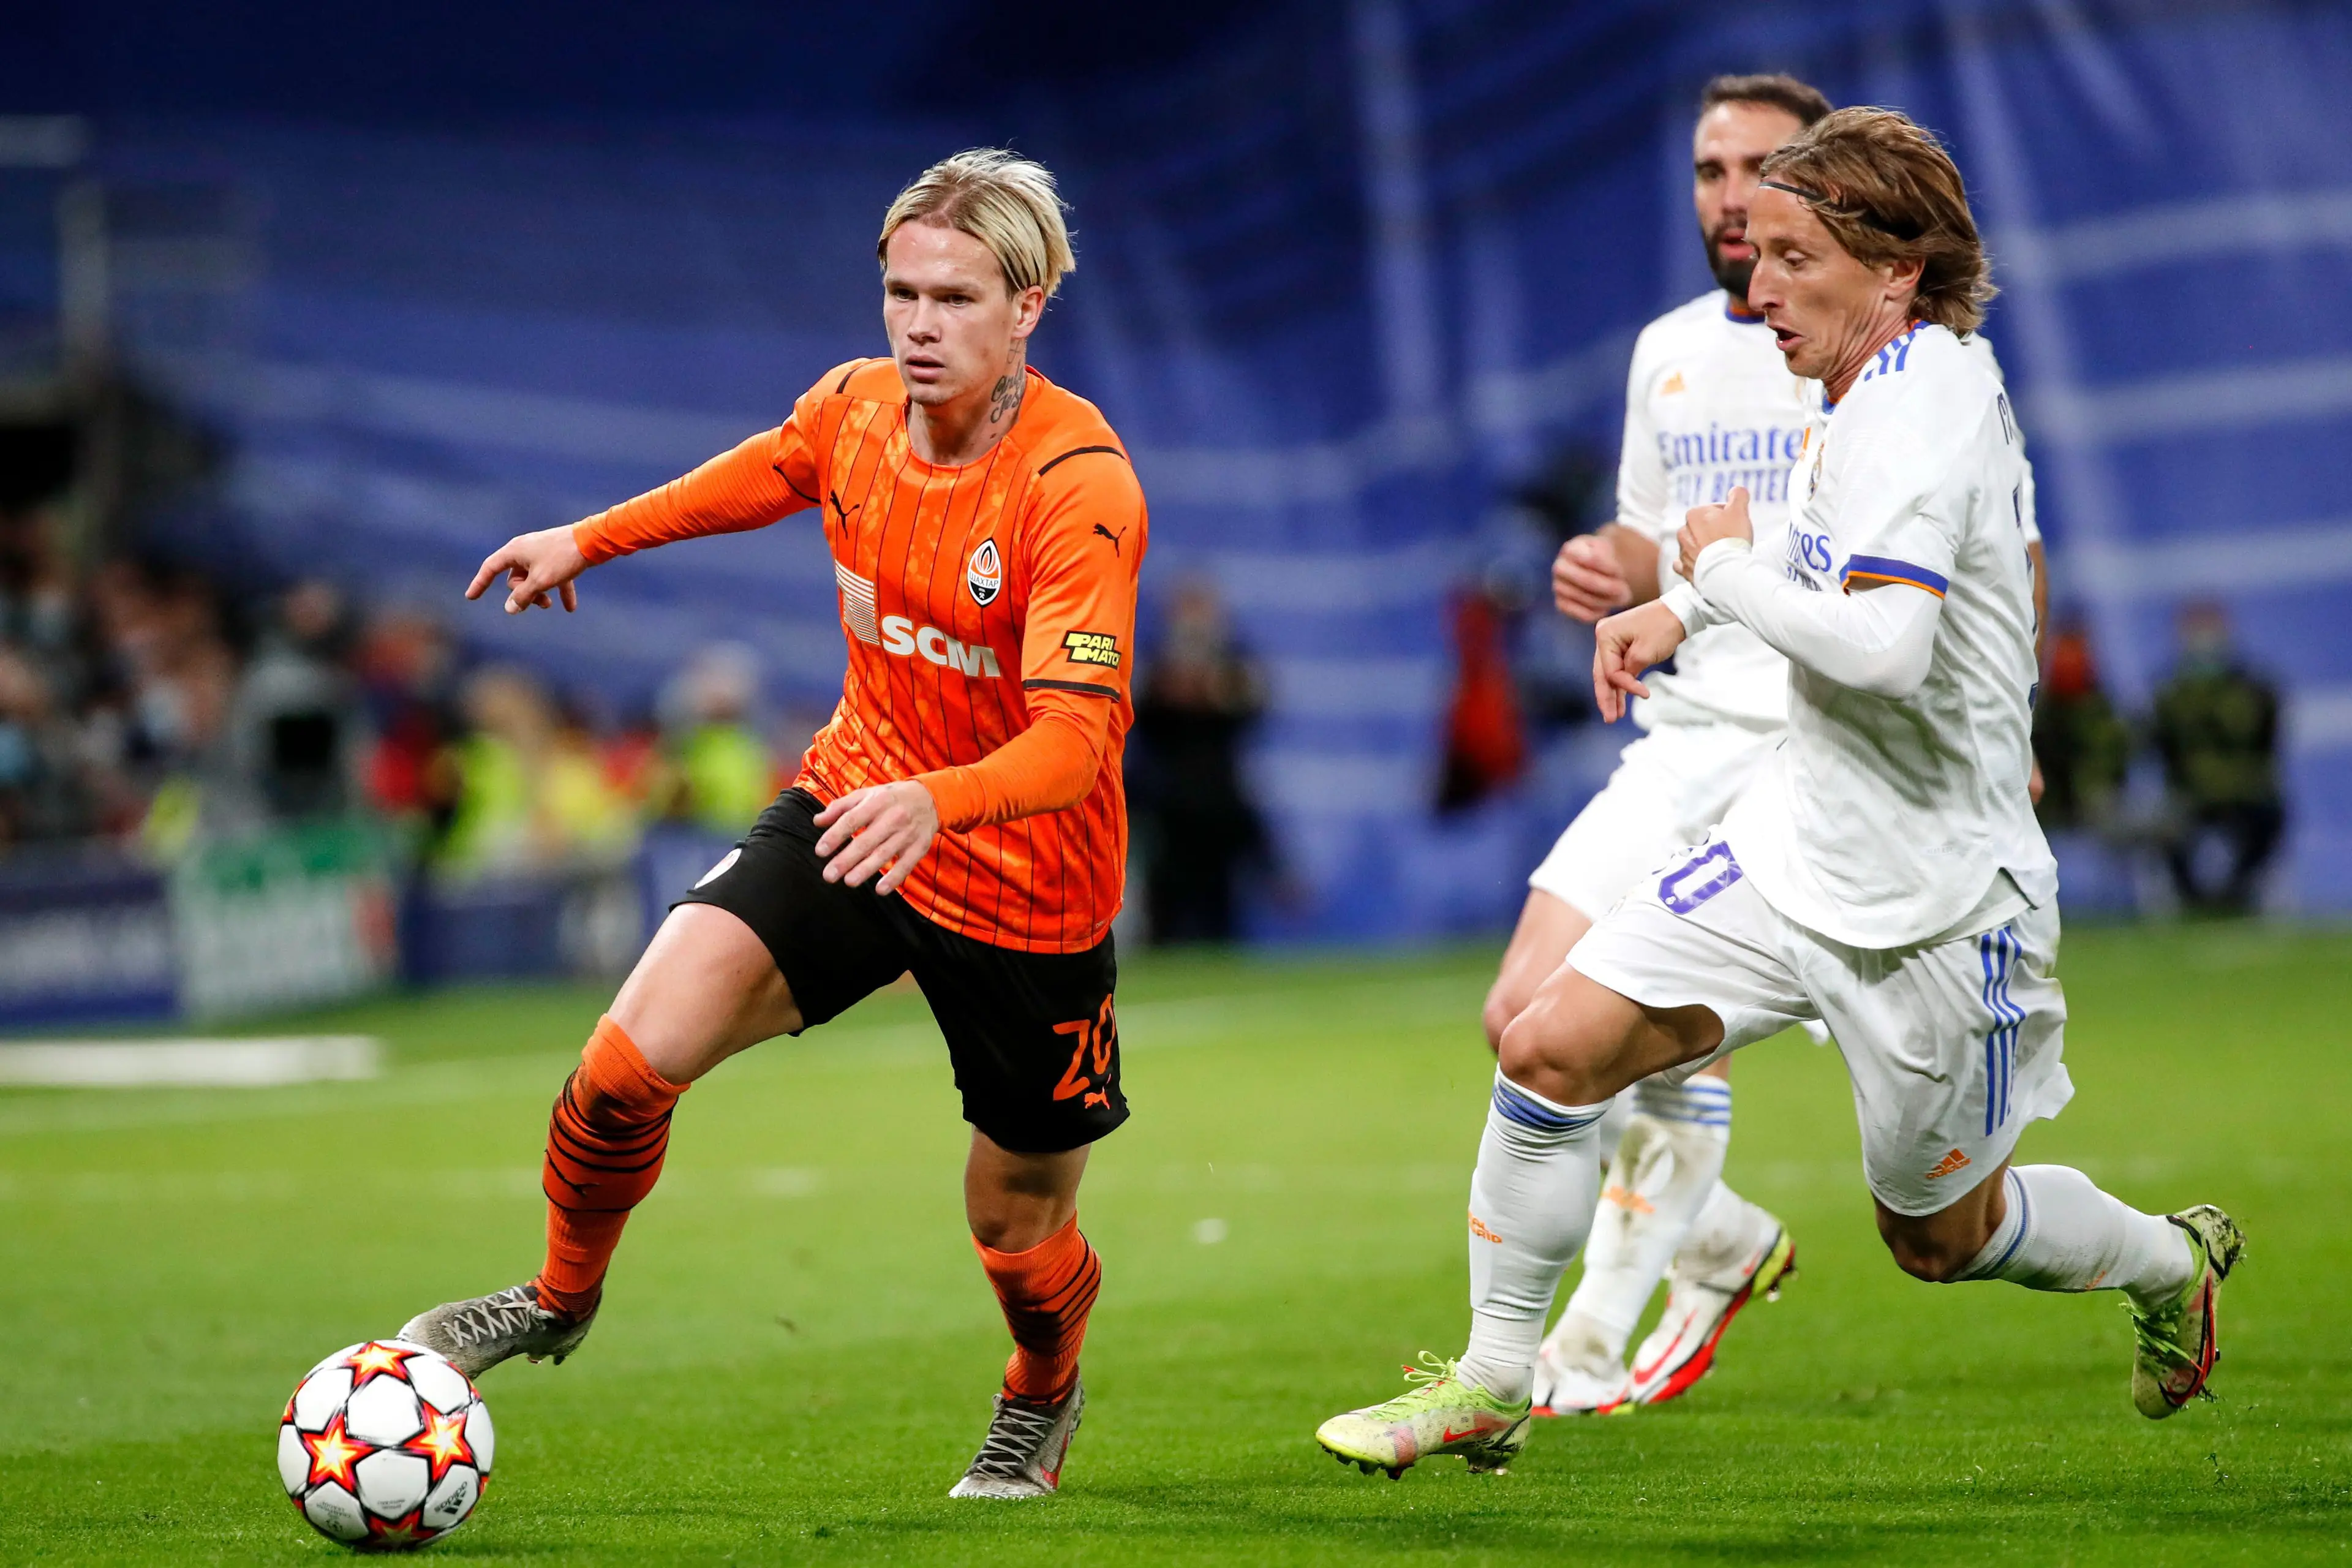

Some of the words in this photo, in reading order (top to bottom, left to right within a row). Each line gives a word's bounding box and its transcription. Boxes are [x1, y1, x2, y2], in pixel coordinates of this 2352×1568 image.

[1657, 421, 1805, 470] Emirate
[881, 615, 1001, 677] SCM
[1066, 633, 1115, 651] PARI
[1052, 993, 1116, 1101] 20
